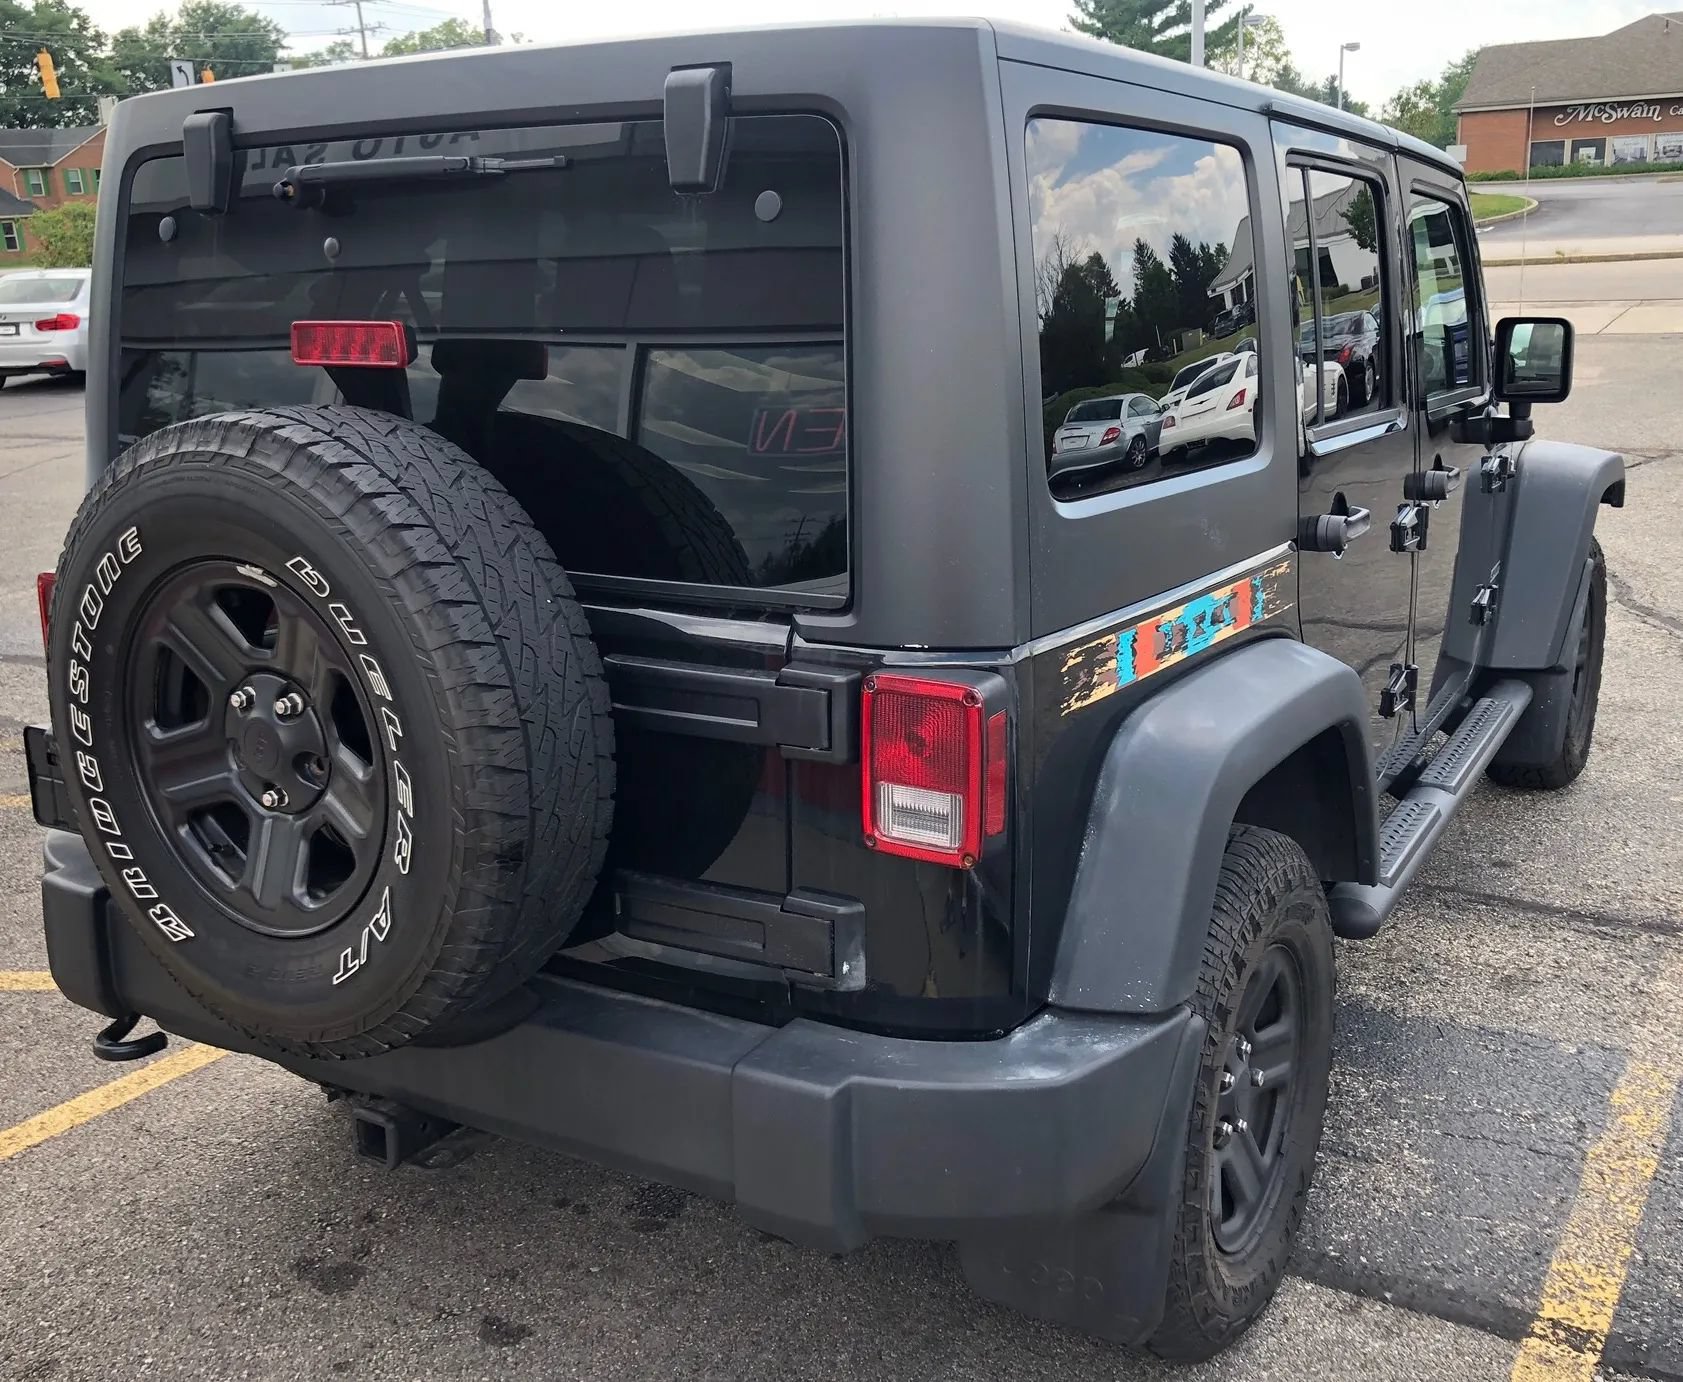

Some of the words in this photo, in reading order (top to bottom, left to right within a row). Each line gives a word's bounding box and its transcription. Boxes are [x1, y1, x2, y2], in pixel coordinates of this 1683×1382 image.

[1554, 102, 1662, 126] McSwain
[69, 526, 195, 941] BRIDGESTONE
[285, 556, 414, 875] DUELER
[332, 886, 392, 985] A/T
